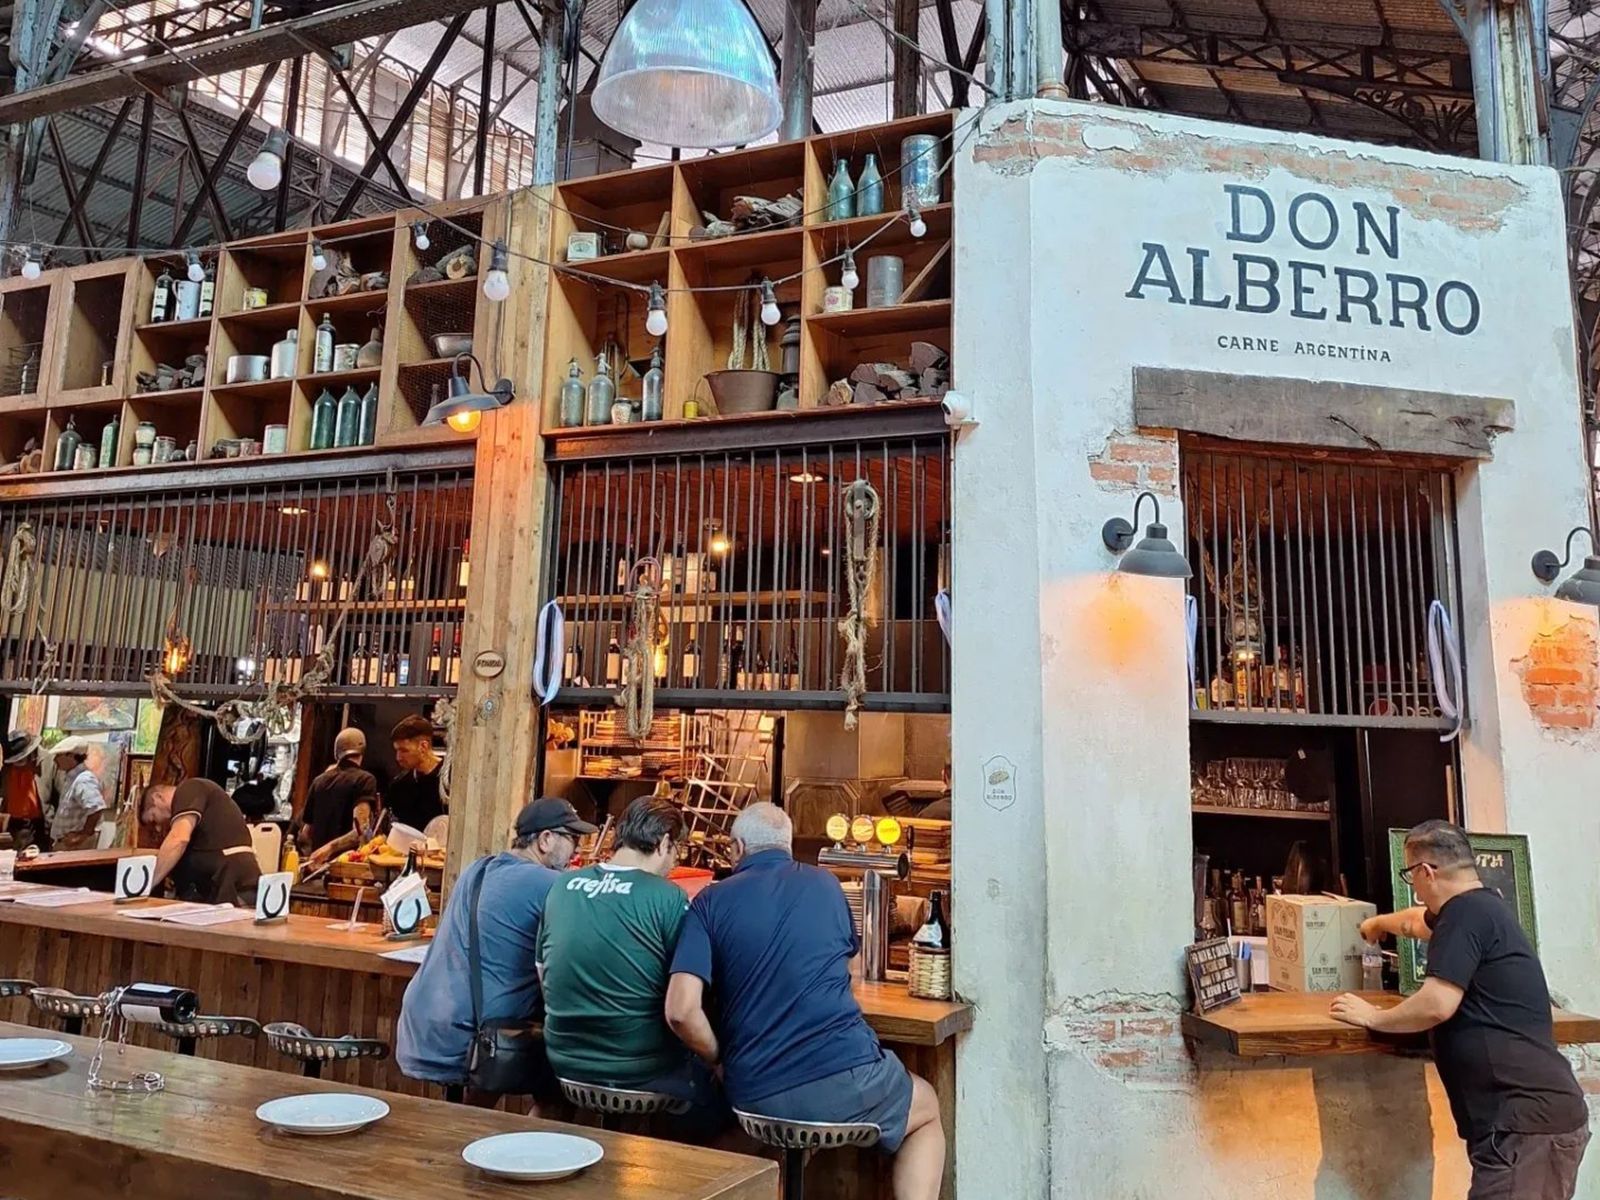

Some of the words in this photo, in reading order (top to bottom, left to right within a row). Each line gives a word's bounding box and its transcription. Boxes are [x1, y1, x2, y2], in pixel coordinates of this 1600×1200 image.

[1223, 184, 1401, 259] DON
[1125, 241, 1481, 336] ALBERRO
[1217, 335, 1279, 352] CARNE
